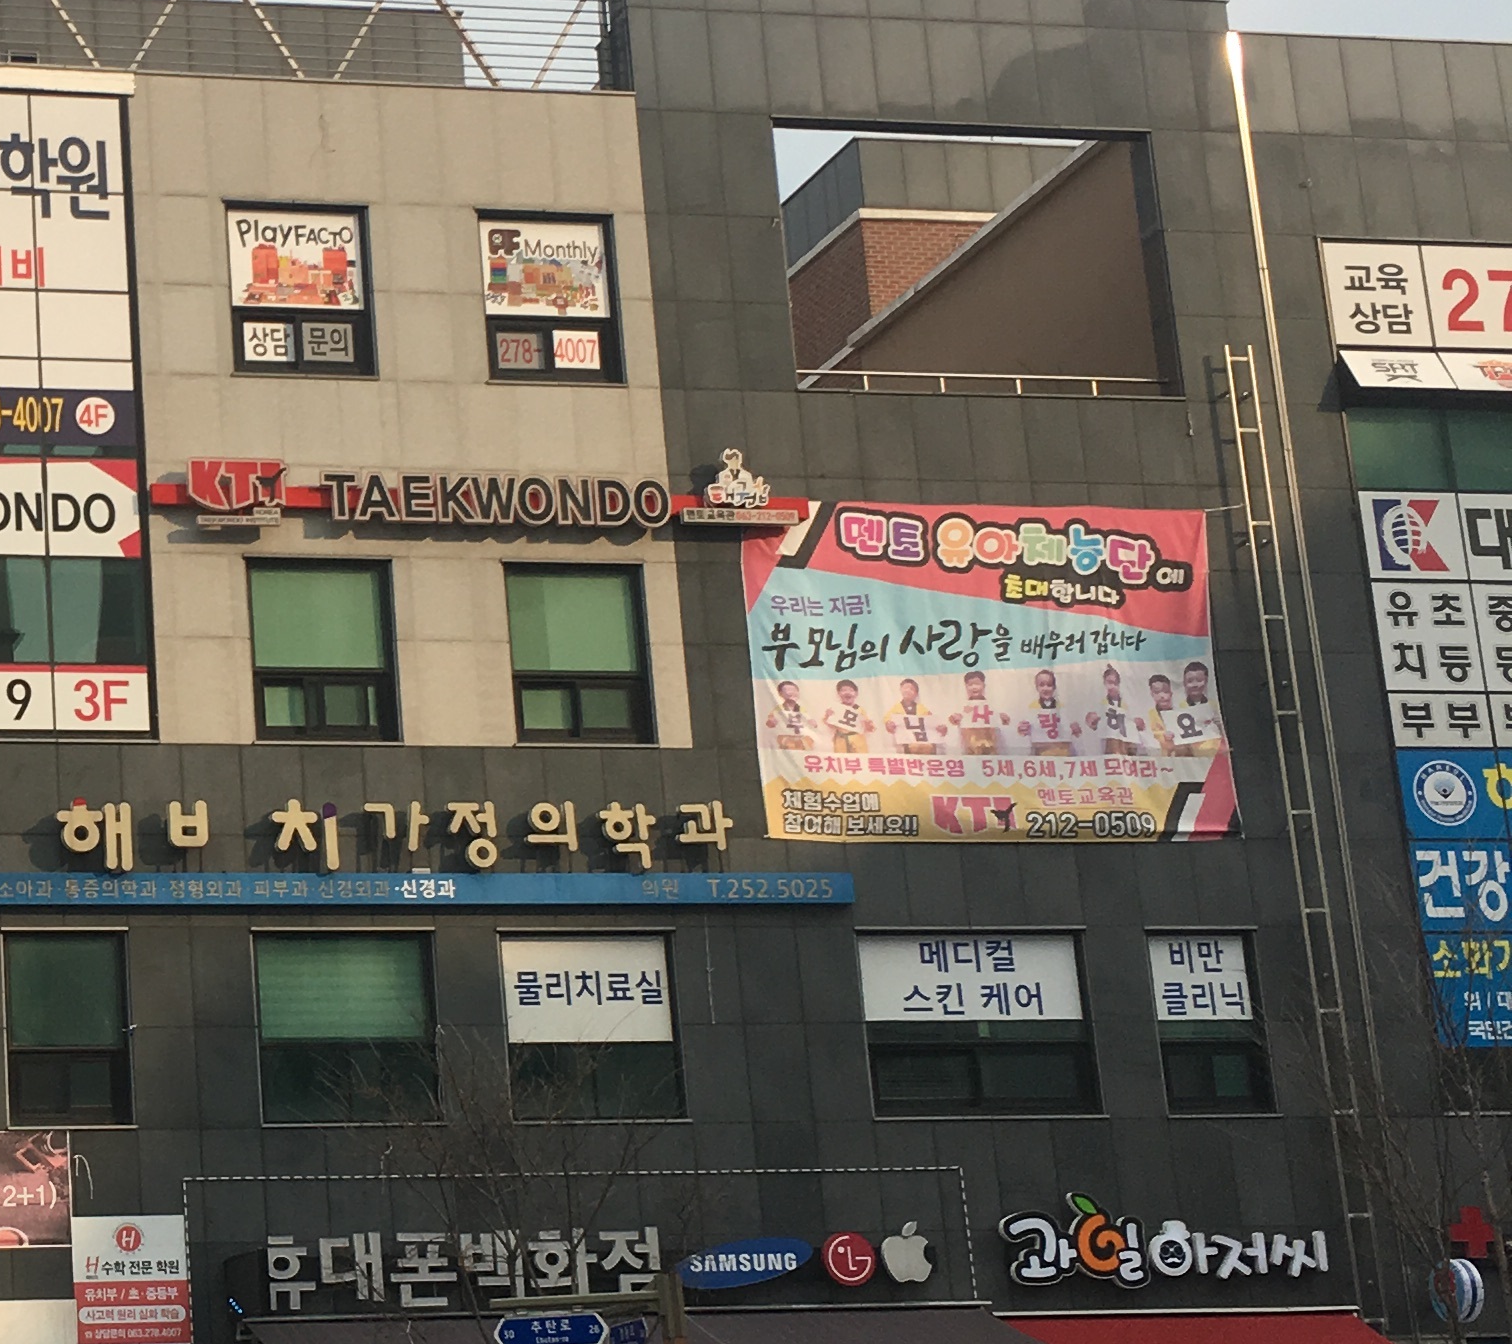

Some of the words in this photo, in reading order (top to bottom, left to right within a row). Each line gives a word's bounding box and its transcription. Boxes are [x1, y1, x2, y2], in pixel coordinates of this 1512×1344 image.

[235, 218, 354, 248] PlayFACTO
[524, 239, 599, 264] Monthly
[1344, 263, 1409, 295] 교육
[1350, 302, 1413, 335] 상담
[248, 326, 291, 357] 상담
[307, 326, 349, 357] 문의
[553, 338, 597, 364] 4007
[77, 404, 109, 428] 4F
[322, 471, 671, 529] TAEKWONDO
[839, 513, 924, 558] 멘토
[770, 594, 825, 618] 우리는
[828, 593, 872, 617] 지금!
[1003, 573, 1121, 606] 초대합니다
[762, 622, 889, 672] 부모님의
[899, 619, 1014, 668] 사랑을
[1090, 624, 1148, 655] 갑니다
[73, 680, 130, 722] 3F
[803, 754, 863, 776] 유치부
[782, 790, 881, 813] 체험수업에
[1037, 787, 1134, 807] 멘토교육관
[783, 813, 841, 837] 참여해
[1026, 812, 1156, 838] 212-0509
[1415, 850, 1511, 923] 건강
[918, 939, 1017, 974] 메디컬
[1168, 939, 1224, 974] 비만
[514, 970, 665, 1007] 물리치료실
[902, 982, 966, 1016] 스킨
[980, 981, 1045, 1016] 케어
[1161, 980, 1247, 1016] 클리닉
[266, 1225, 662, 1311] 휴대폰백화점
[689, 1251, 797, 1273] SAMSUNG
[530, 1318, 572, 1335] 추탄로
